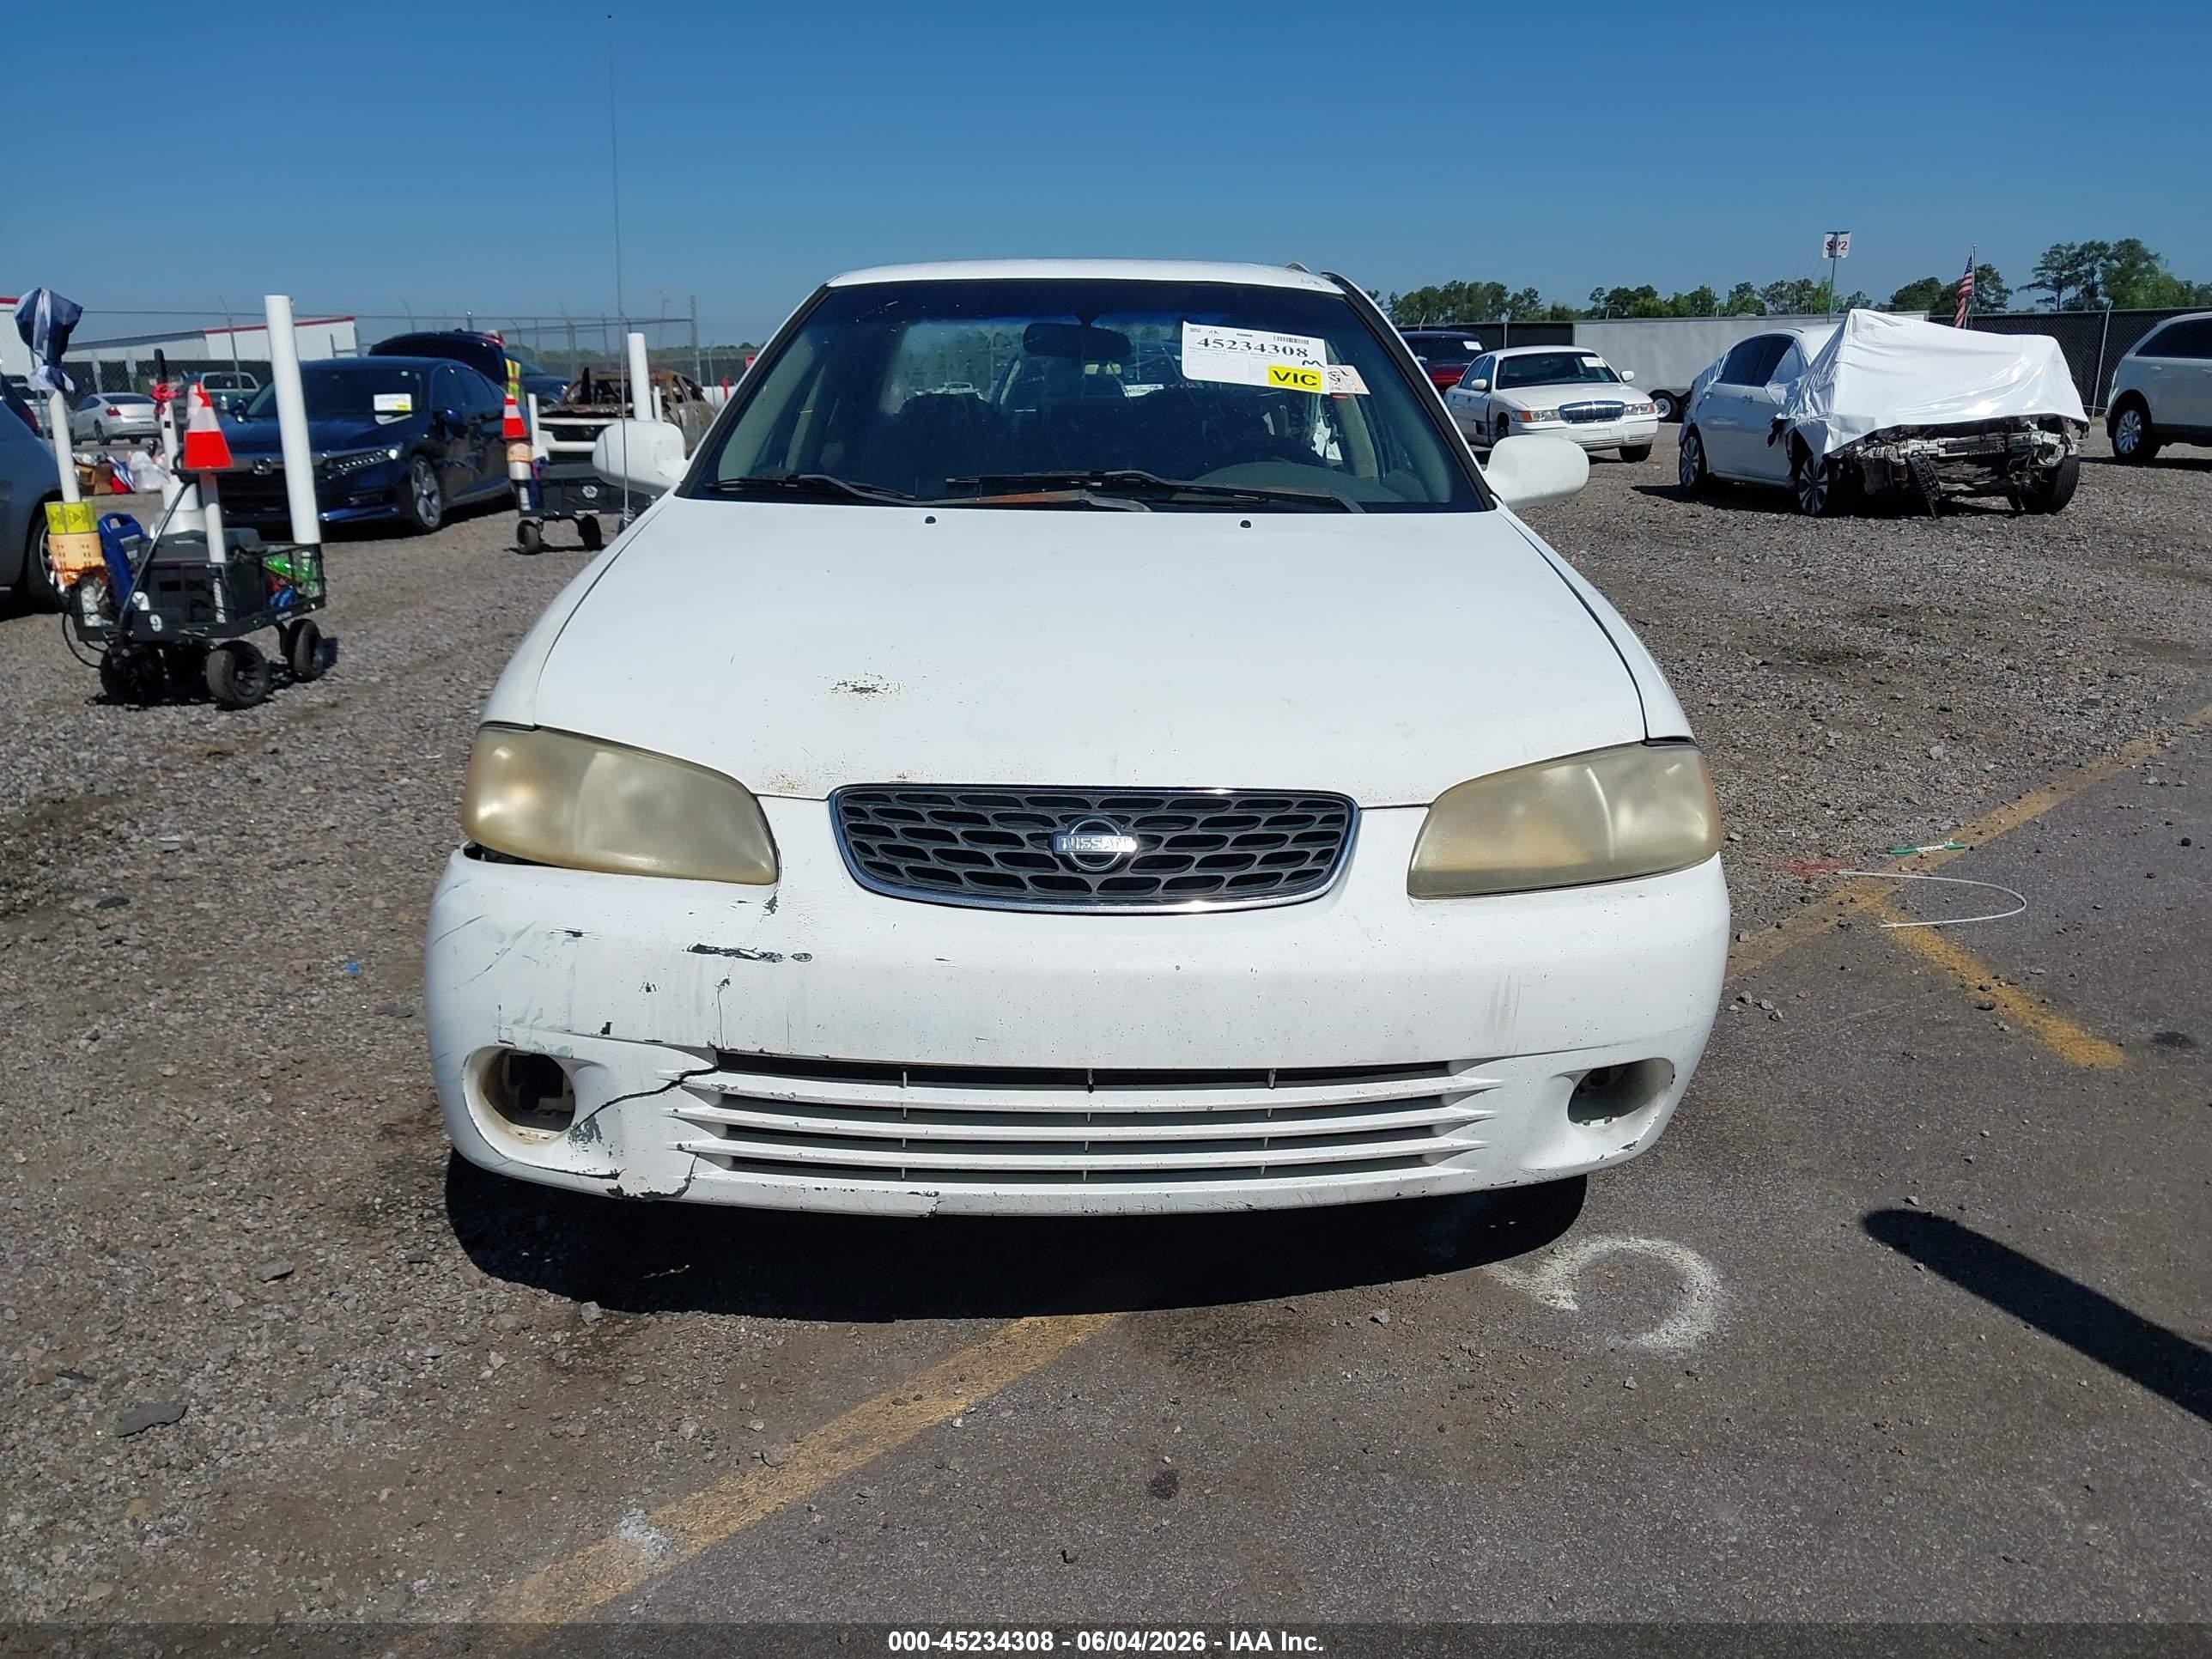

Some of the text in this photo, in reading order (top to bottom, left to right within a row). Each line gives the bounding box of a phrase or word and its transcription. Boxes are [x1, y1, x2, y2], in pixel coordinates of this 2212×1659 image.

[1197, 337, 1309, 358] 45234308
[1271, 369, 1318, 386] VIC
[1060, 836, 1132, 850] NISSAN
